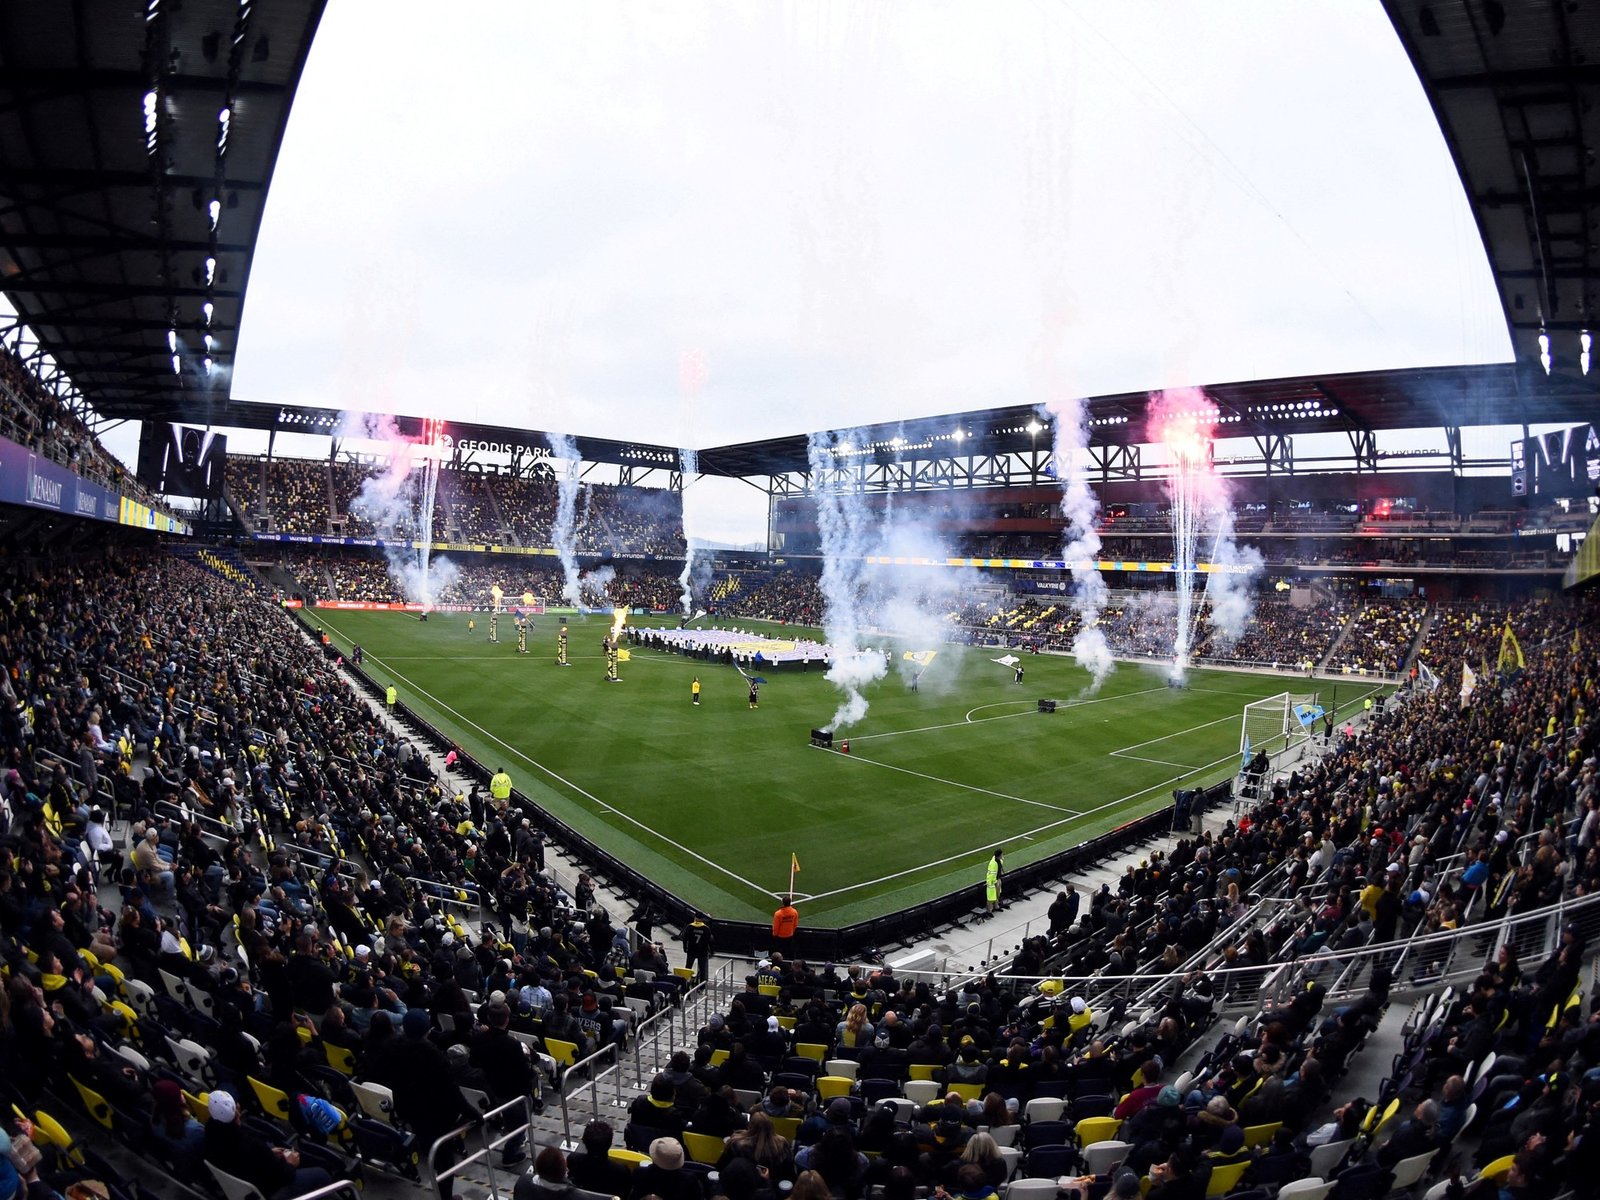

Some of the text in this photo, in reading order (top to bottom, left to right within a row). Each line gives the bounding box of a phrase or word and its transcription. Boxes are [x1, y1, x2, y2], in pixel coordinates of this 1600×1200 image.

[458, 439, 551, 459] GEODIS PARK
[1036, 581, 1059, 589] VALKYRIE
